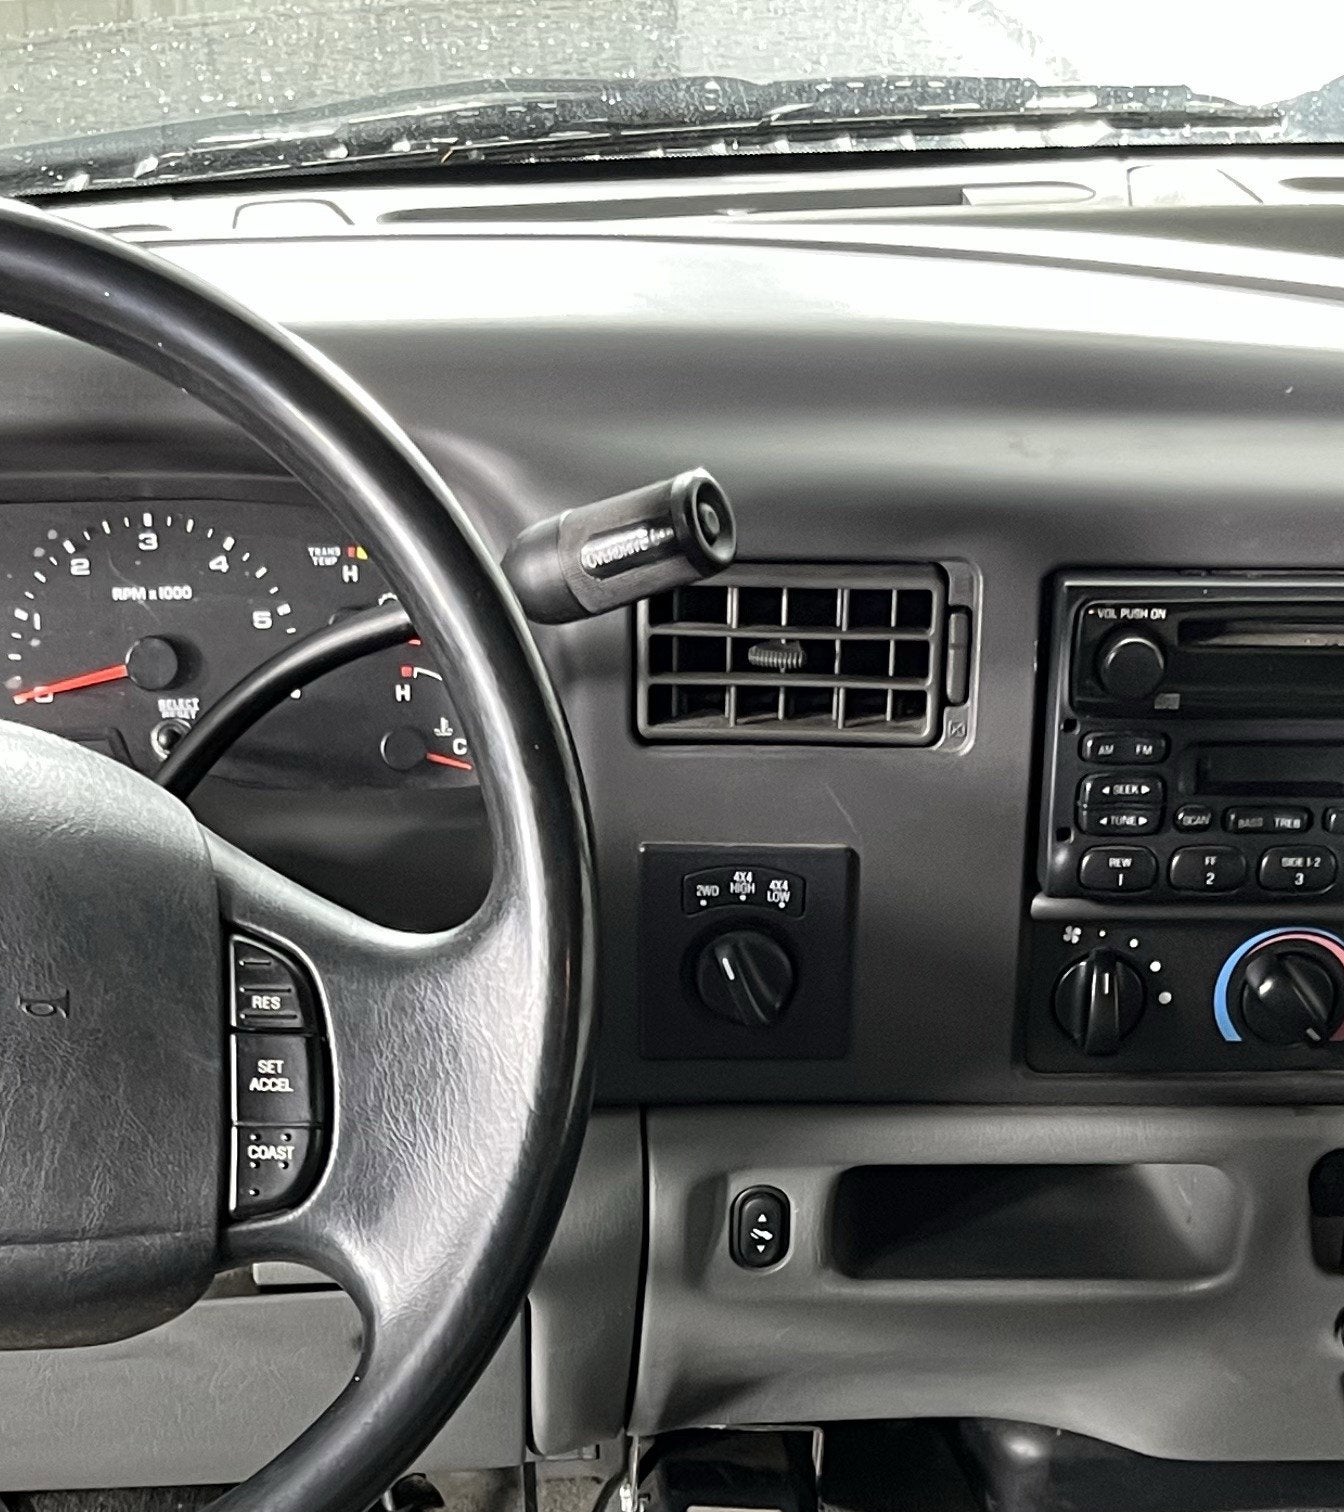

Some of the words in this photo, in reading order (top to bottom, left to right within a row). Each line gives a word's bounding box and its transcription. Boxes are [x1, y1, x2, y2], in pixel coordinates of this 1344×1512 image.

[138, 532, 158, 551] 3
[70, 557, 91, 576] 2
[209, 555, 230, 573] 4
[342, 564, 359, 583] H
[112, 586, 147, 601] RPM
[1097, 609, 1117, 619] VOL
[1120, 608, 1148, 619] PUSH
[1150, 608, 1166, 620] ON
[395, 684, 411, 702] H
[453, 738, 468, 755] C
[1135, 744, 1153, 755] FM
[733, 871, 753, 883] 4X4
[1117, 873, 1124, 886] 1
[1206, 872, 1215, 885] 2
[1294, 872, 1304, 885] 3
[696, 885, 720, 897] 2WD
[730, 882, 756, 894] HIGH
[769, 880, 789, 891] 4X4
[767, 891, 791, 903] LOW
[251, 995, 281, 1010] RES
[257, 1060, 284, 1074] SET
[249, 1078, 294, 1092] ACCEL
[247, 1145, 295, 1160] COAST
